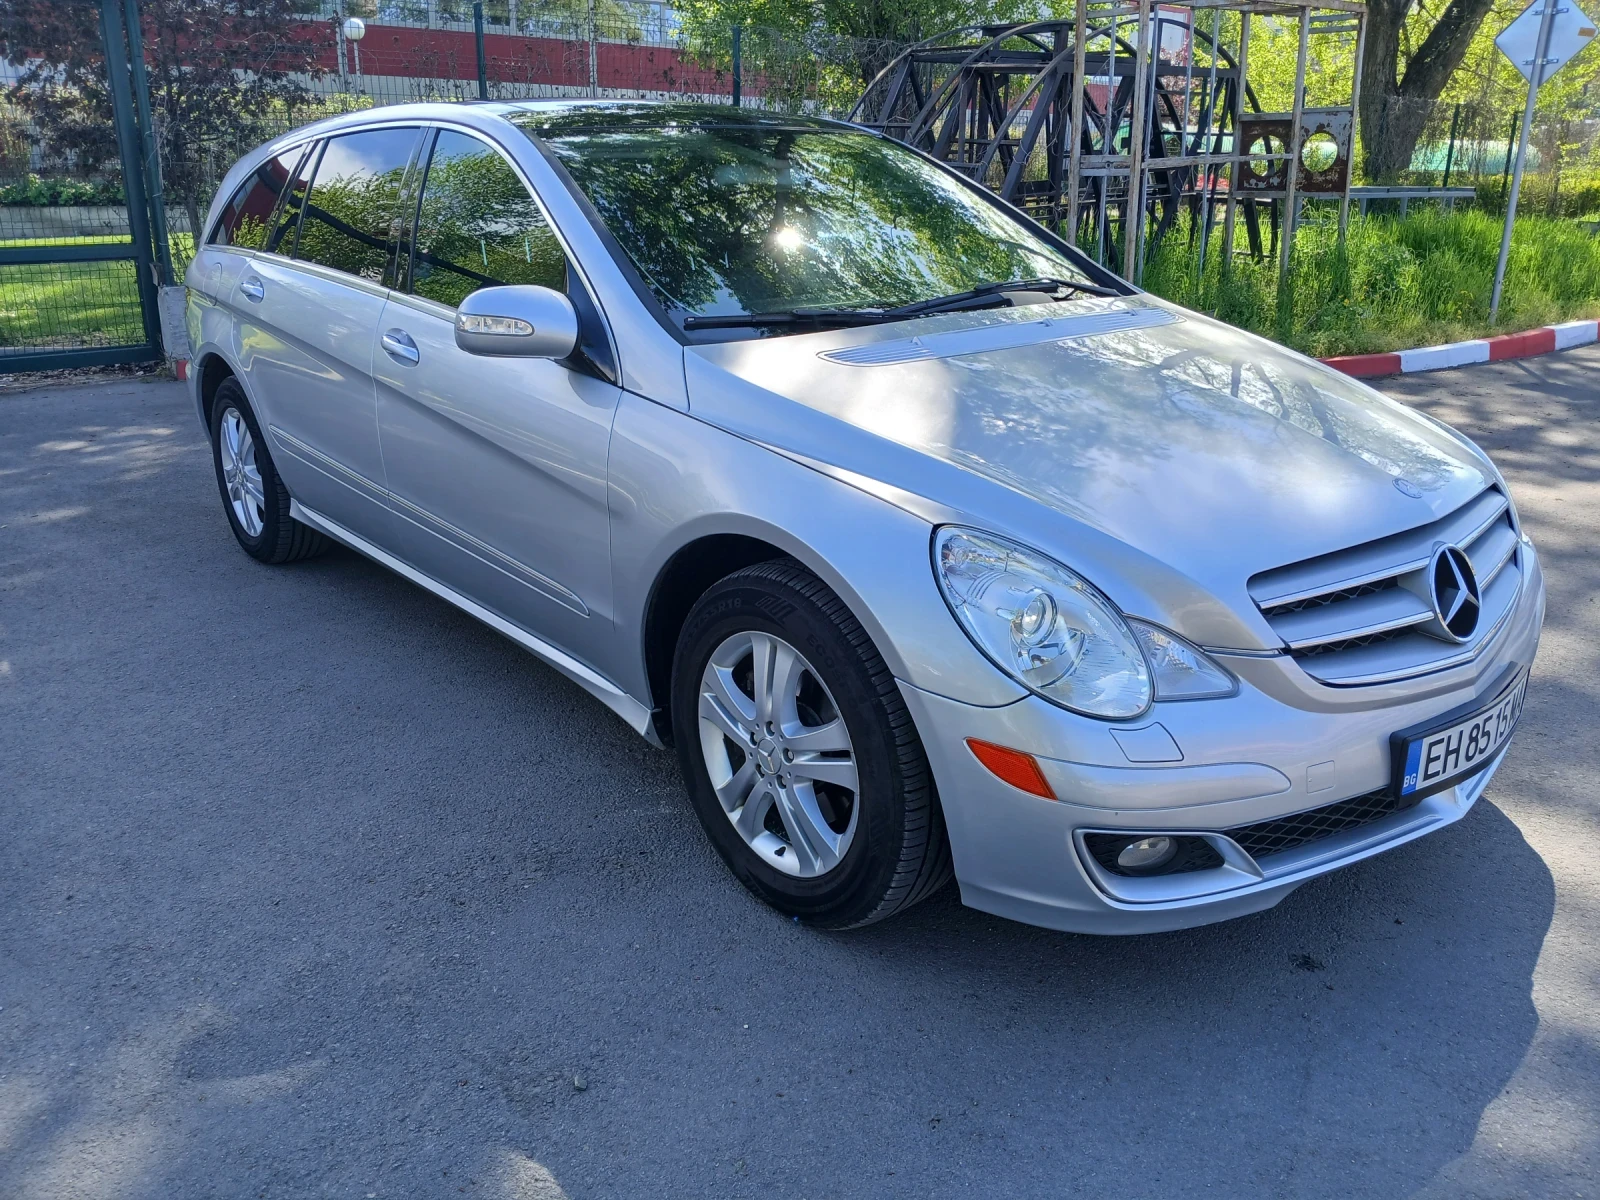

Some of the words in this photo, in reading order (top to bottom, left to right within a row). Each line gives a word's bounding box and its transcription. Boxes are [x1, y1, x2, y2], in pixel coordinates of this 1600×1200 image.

[1423, 730, 1463, 782] EH
[1465, 700, 1510, 762] 8515
[1404, 773, 1416, 788] BG
